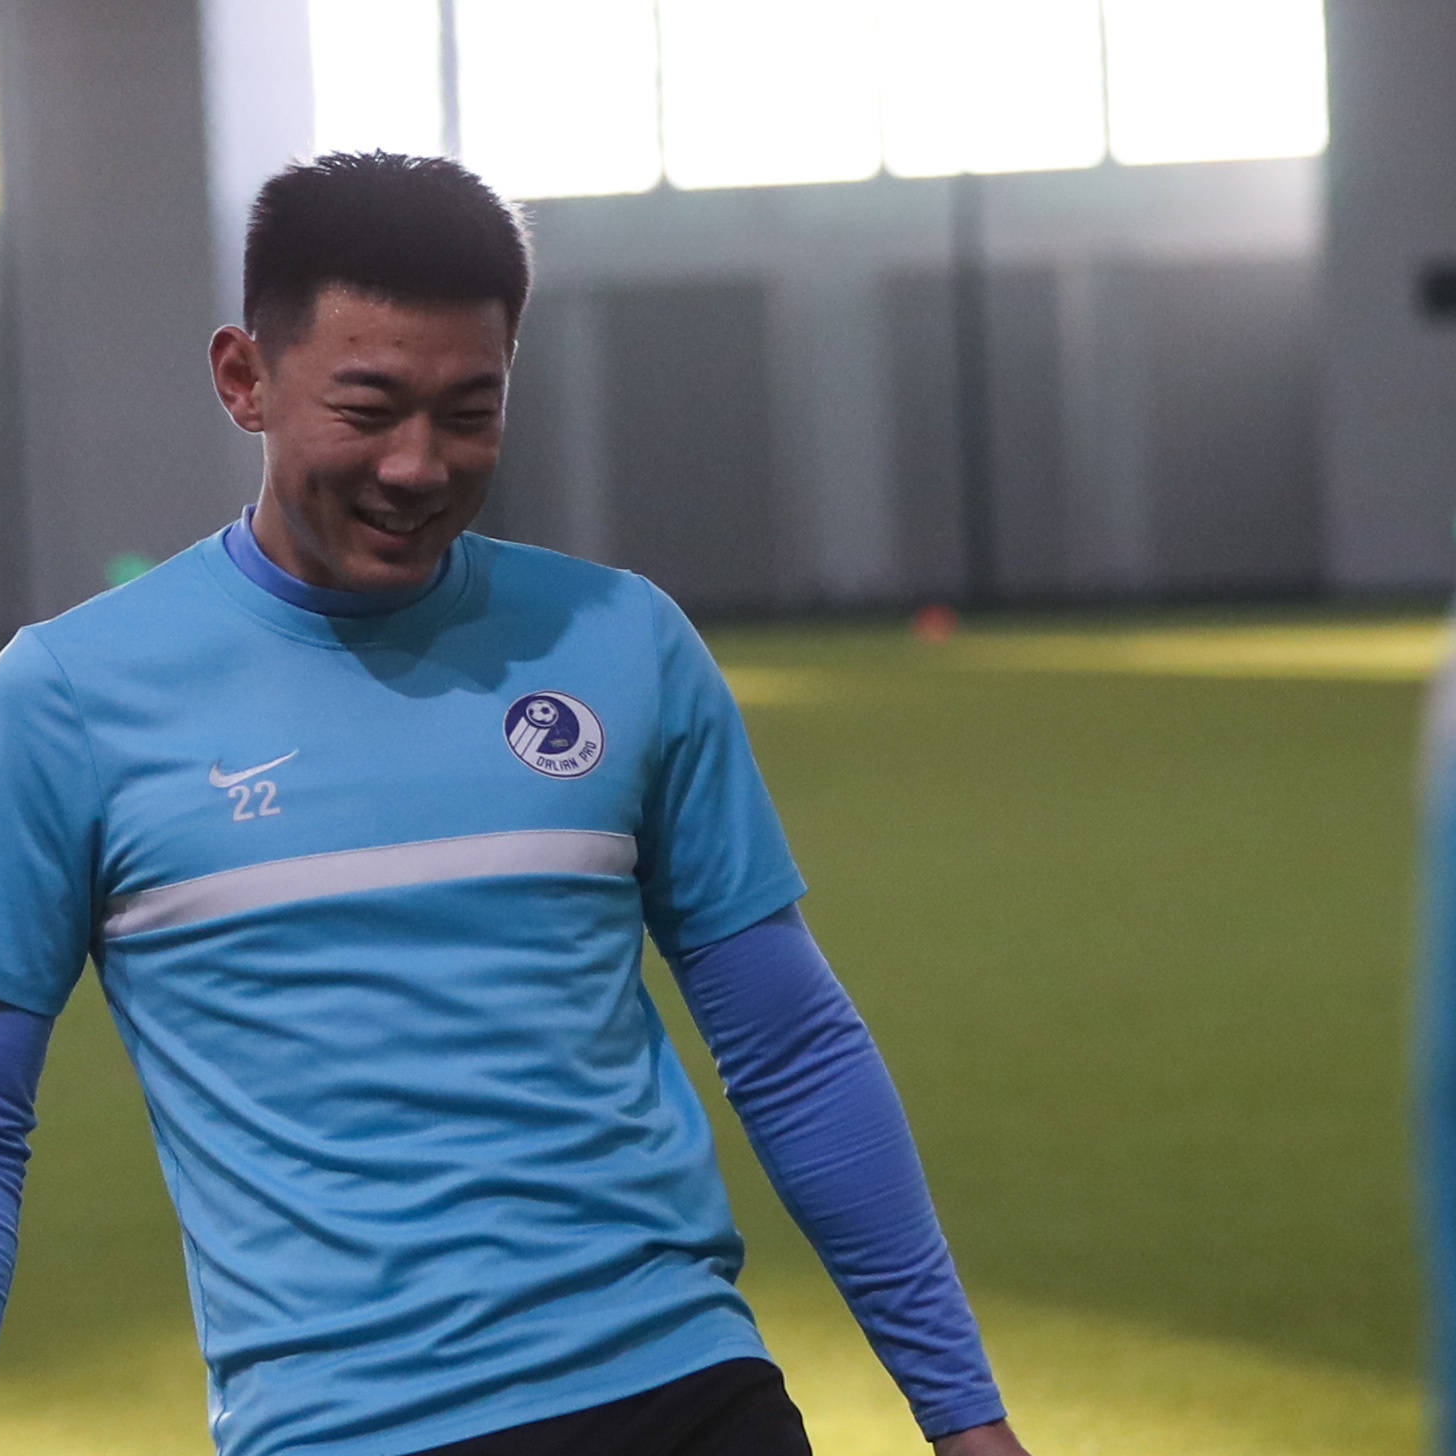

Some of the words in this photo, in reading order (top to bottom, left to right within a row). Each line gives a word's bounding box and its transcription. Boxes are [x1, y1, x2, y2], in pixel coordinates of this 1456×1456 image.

[537, 756, 579, 771] DALIAN
[579, 741, 598, 762] PRO
[229, 781, 281, 821] 22
